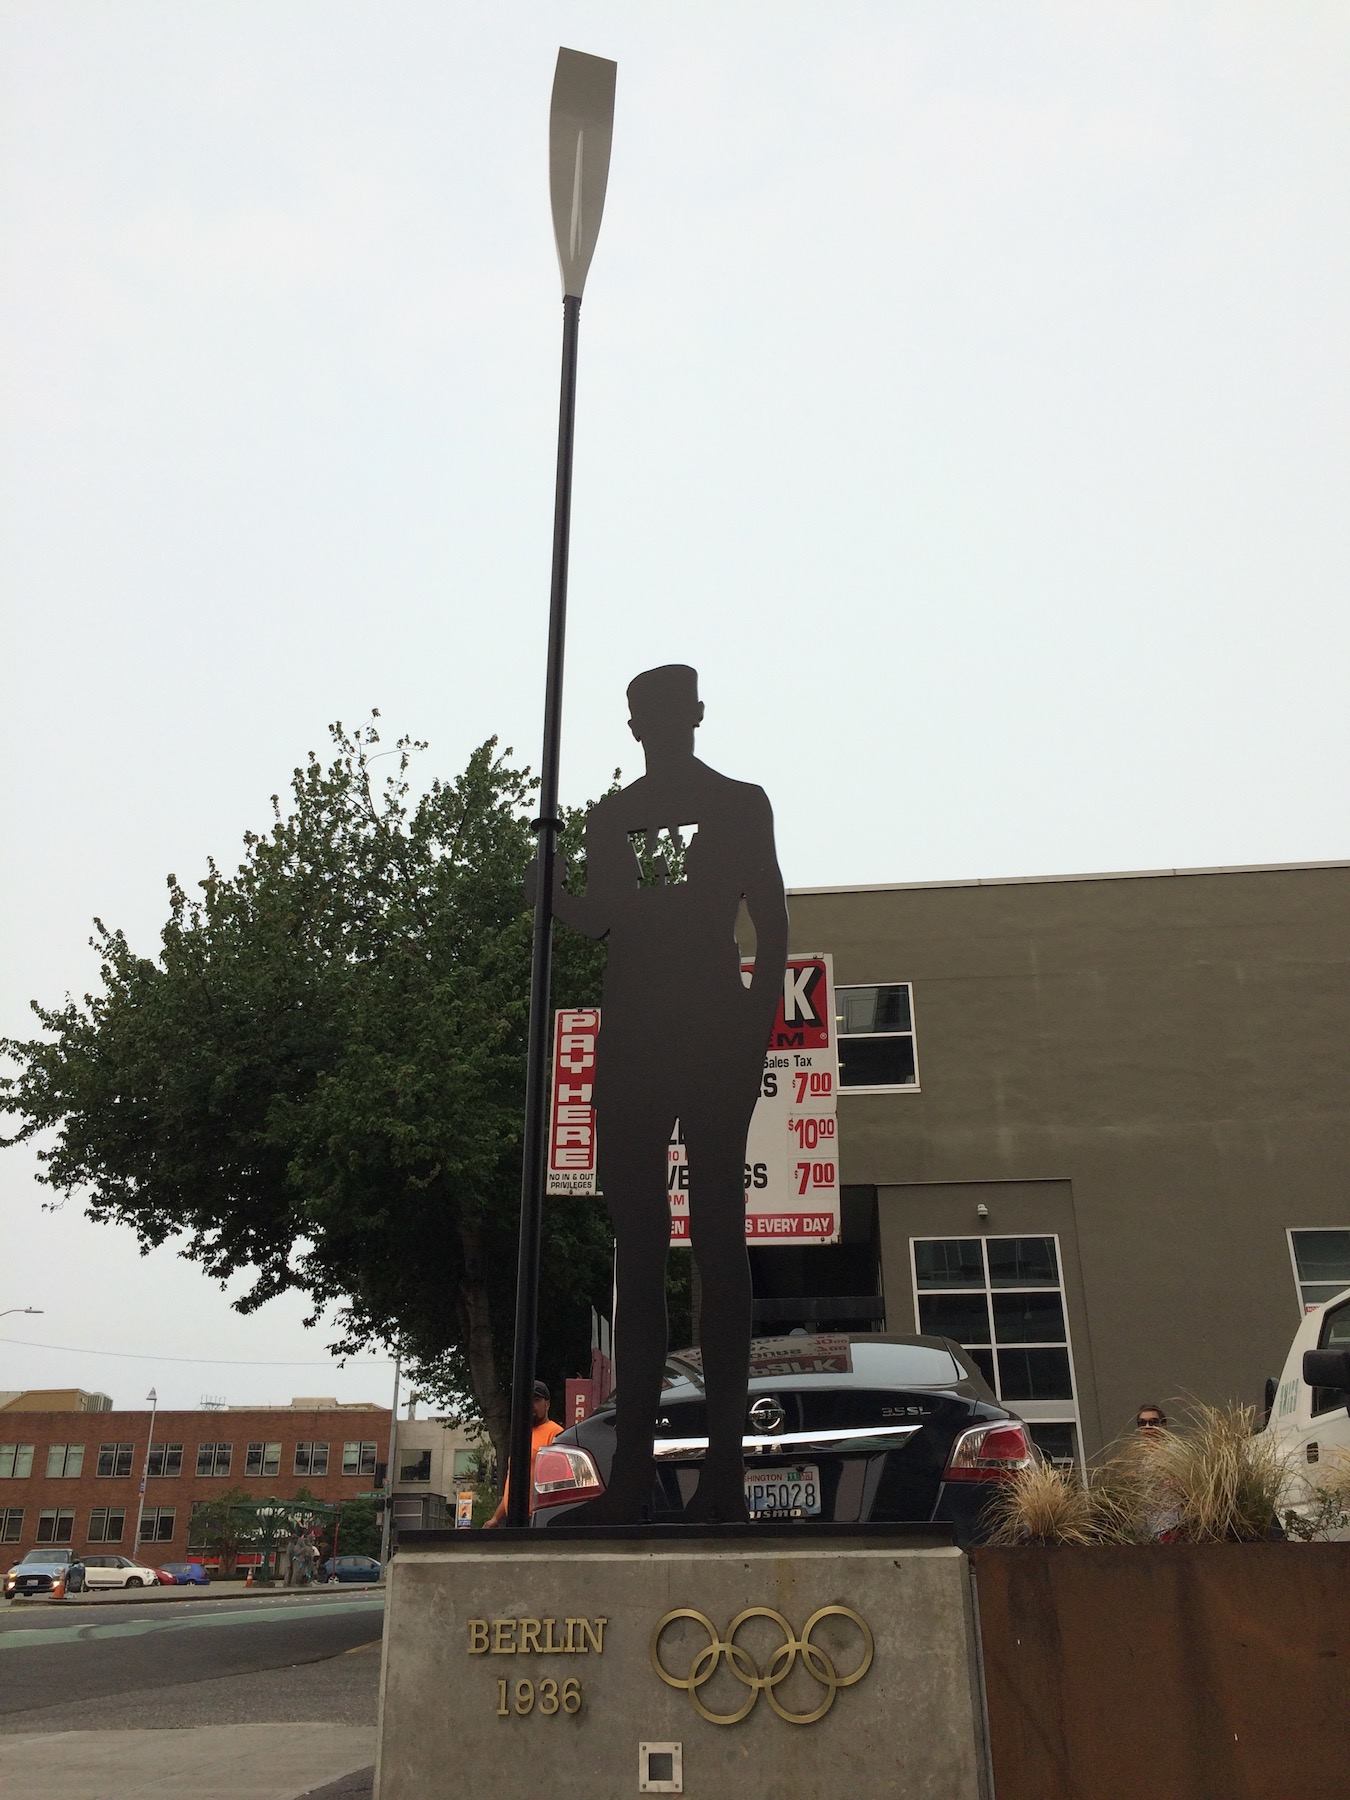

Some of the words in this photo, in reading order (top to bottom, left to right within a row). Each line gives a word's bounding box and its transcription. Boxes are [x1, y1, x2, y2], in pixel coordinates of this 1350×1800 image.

[560, 1014, 597, 1074] PAY
[794, 1055, 812, 1067] Tax
[555, 1083, 593, 1168] HERE
[548, 1173, 560, 1181] NO
[550, 1181, 593, 1189] PRIVILEGES
[757, 1219, 799, 1233] EVERY
[803, 1217, 831, 1232] DAY
[467, 1617, 608, 1655] BERLIN
[496, 1677, 583, 1716] 1936
